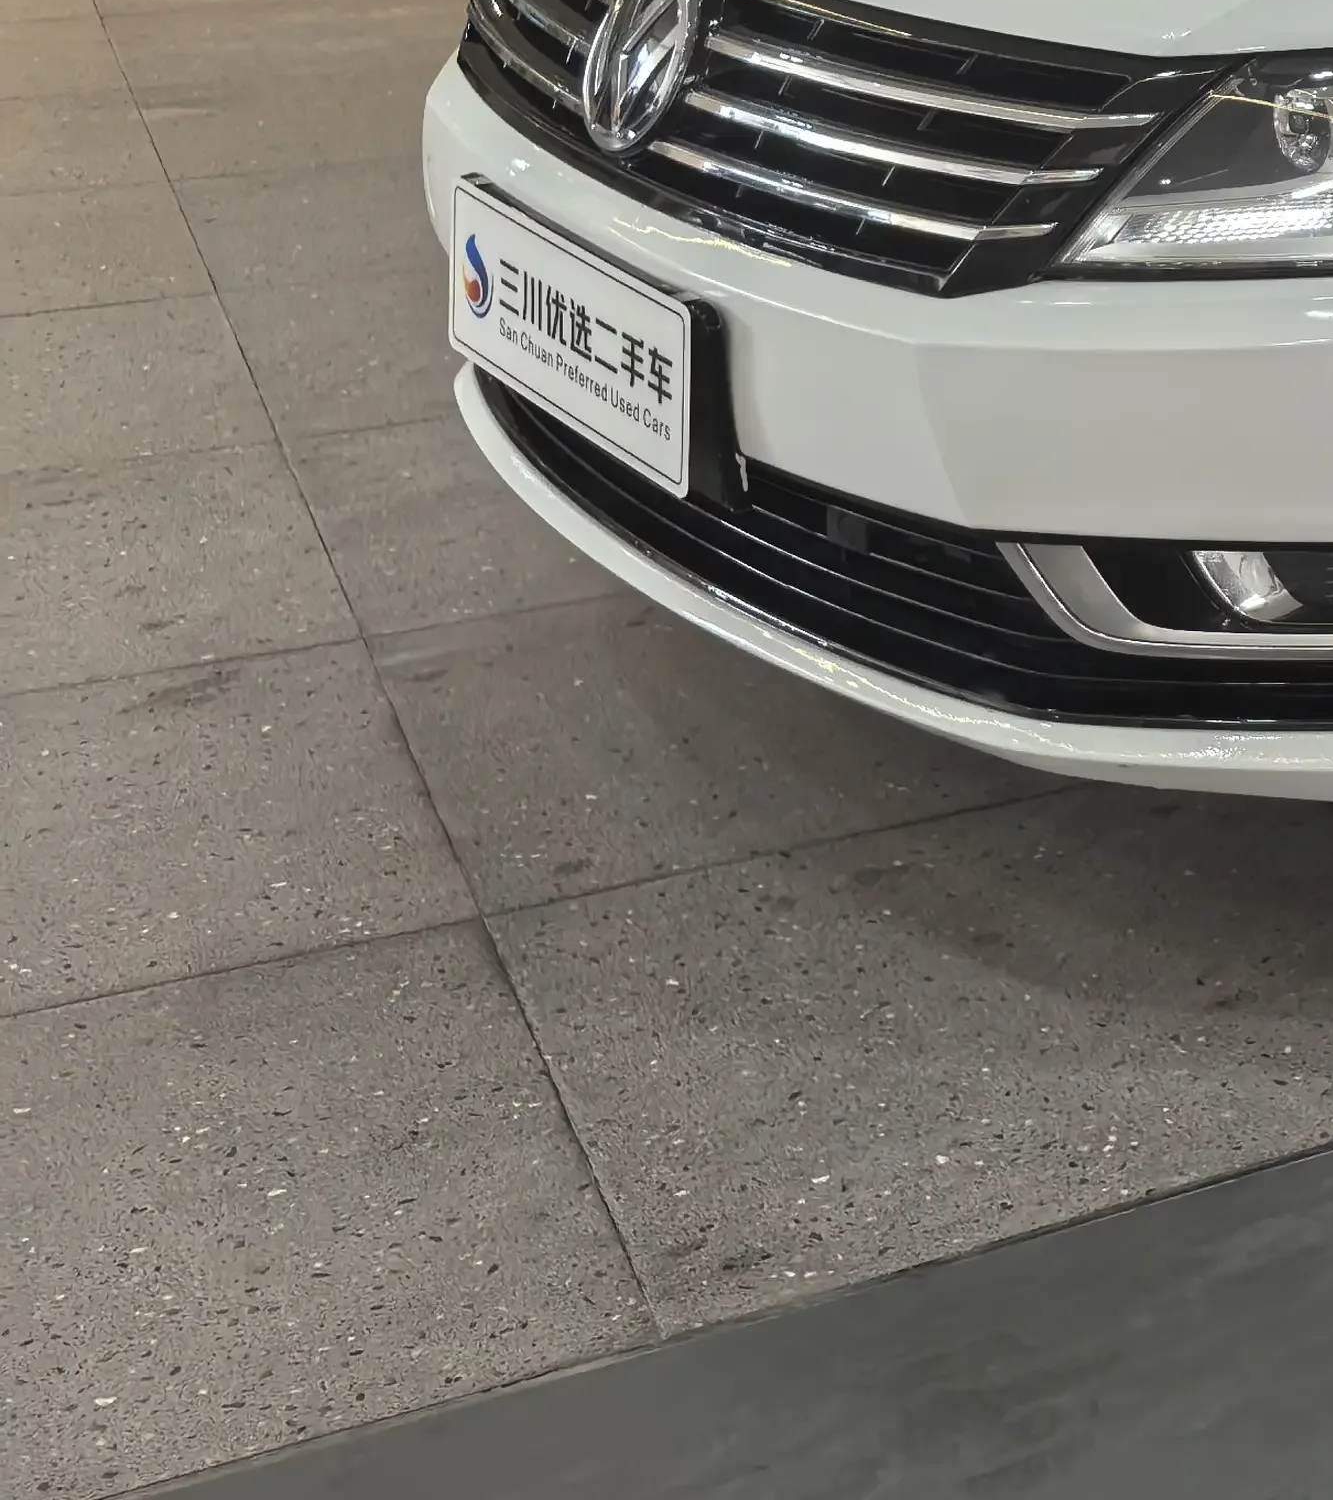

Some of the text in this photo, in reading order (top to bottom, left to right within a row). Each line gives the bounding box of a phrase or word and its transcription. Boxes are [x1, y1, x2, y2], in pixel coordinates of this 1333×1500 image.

[498, 258, 673, 404] 三川优选二手车
[499, 317, 672, 441] San Chuan Preferred Used Cars
